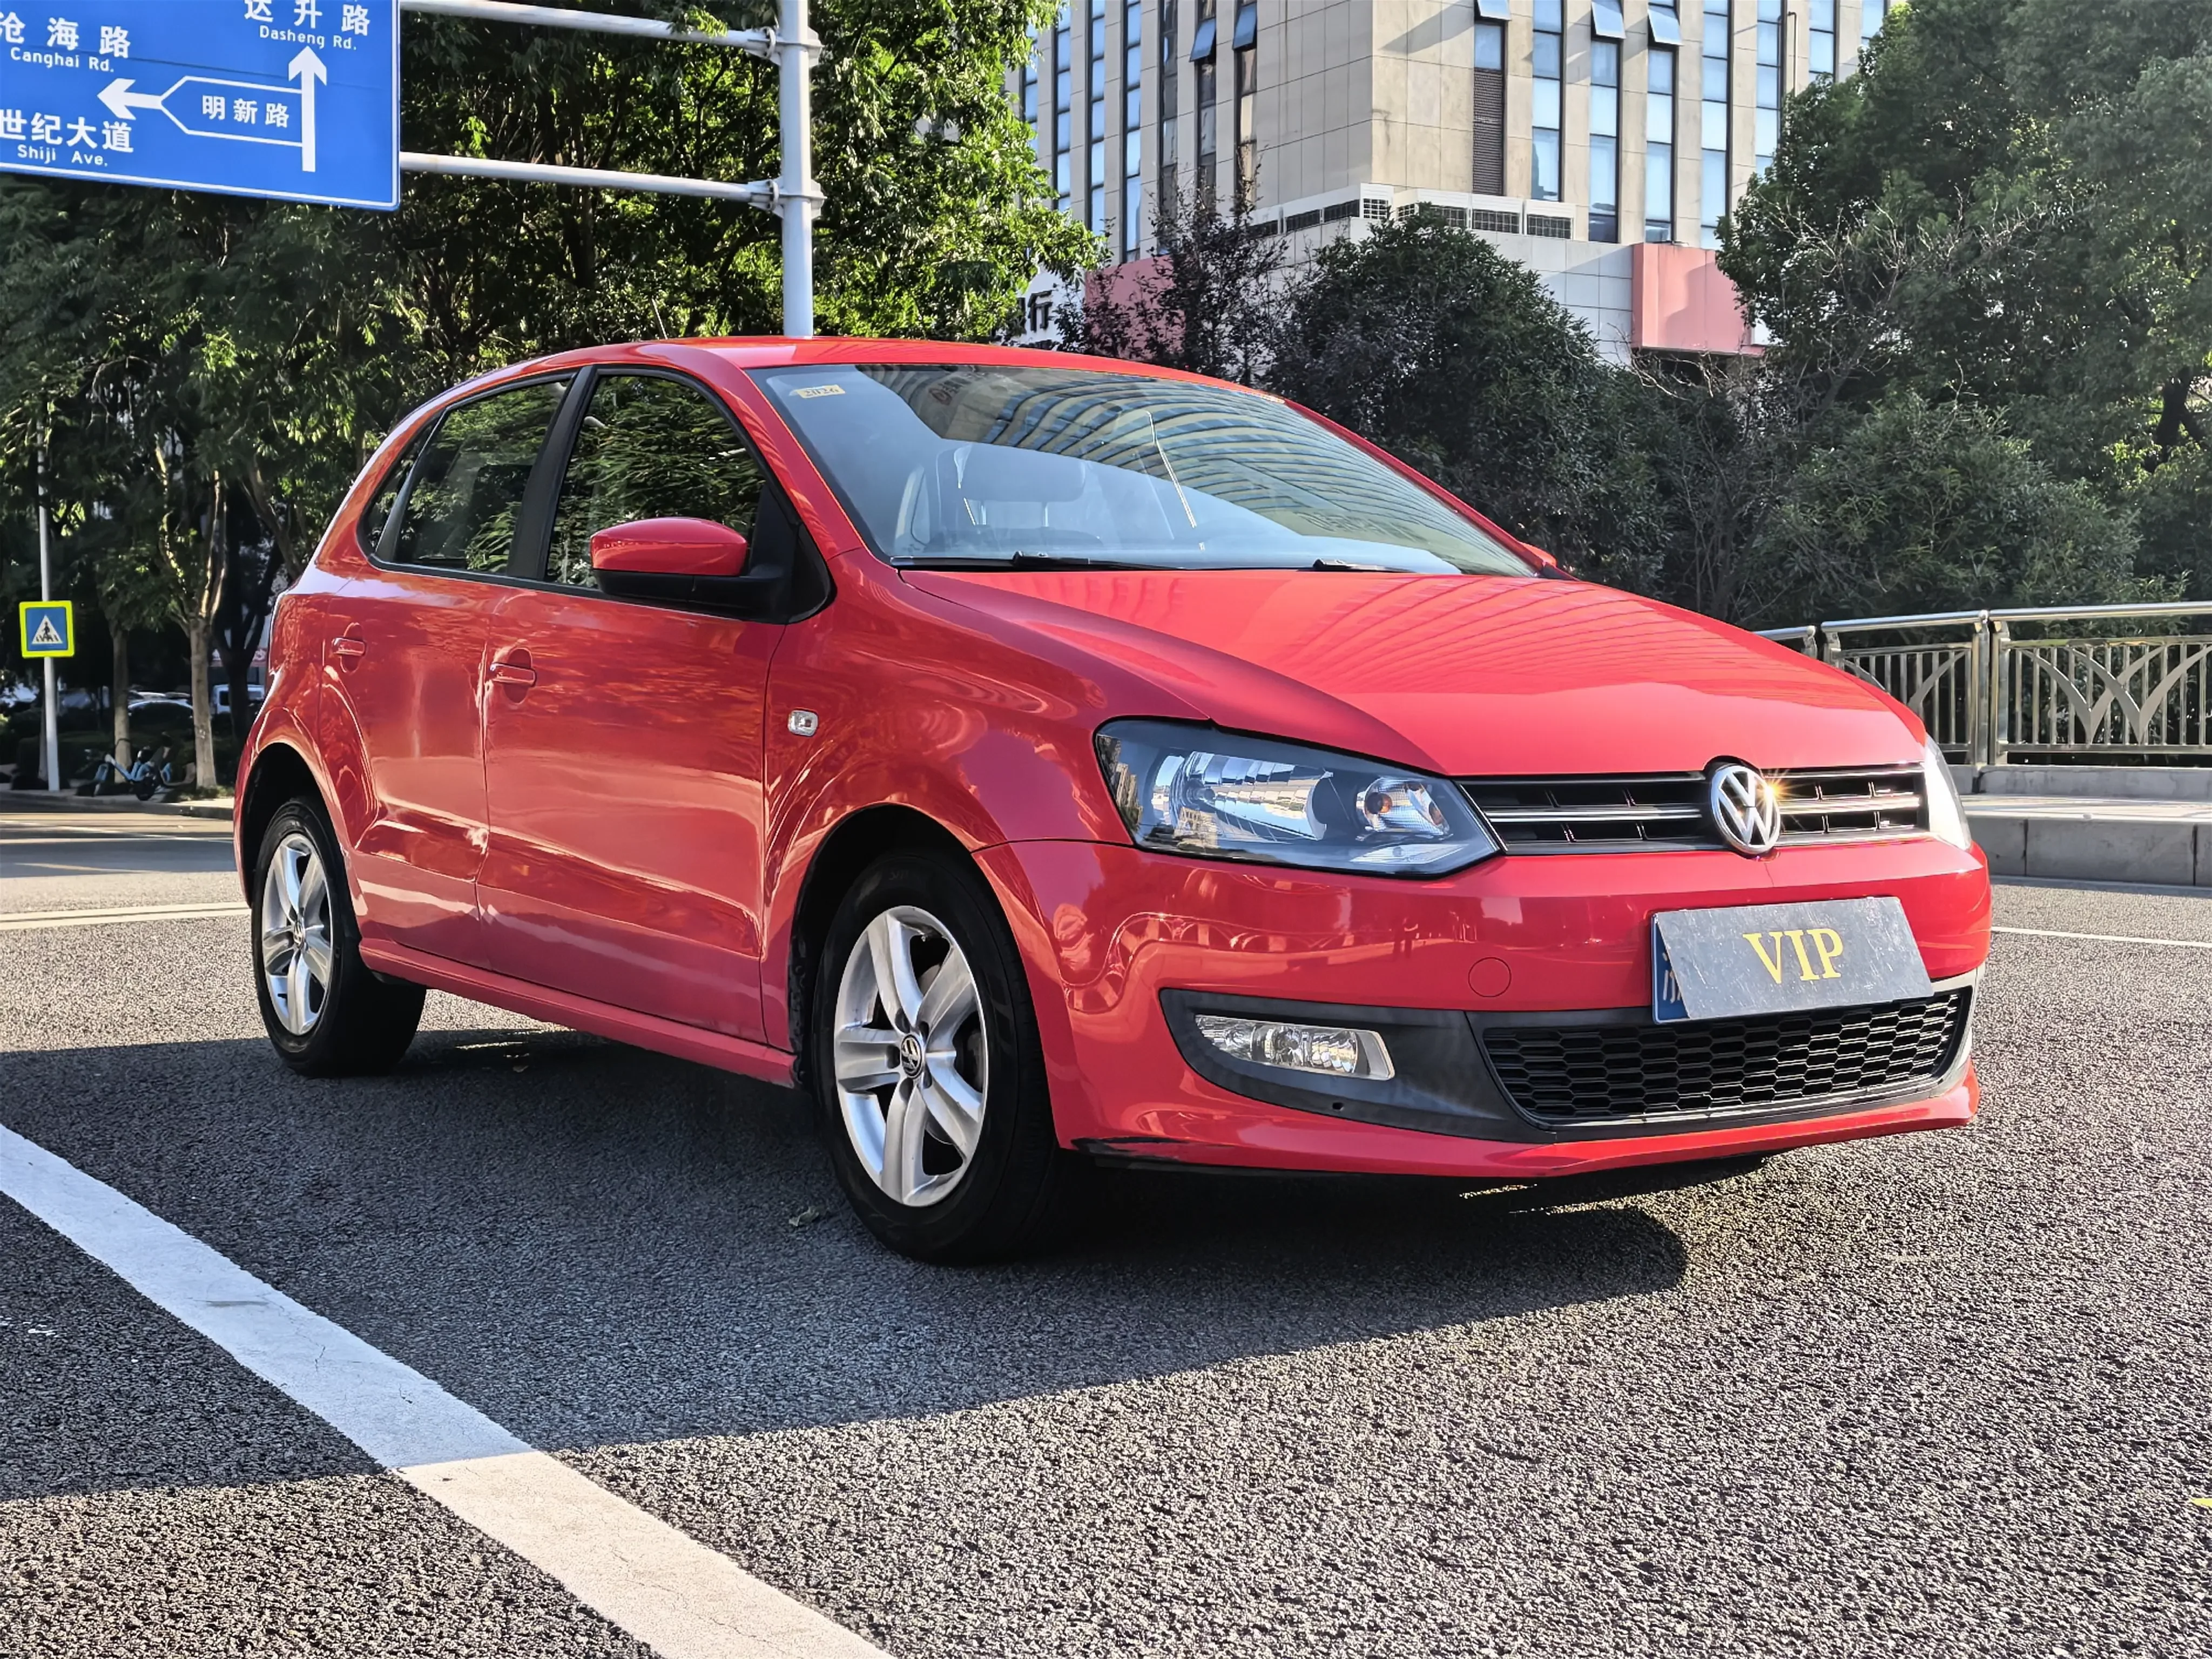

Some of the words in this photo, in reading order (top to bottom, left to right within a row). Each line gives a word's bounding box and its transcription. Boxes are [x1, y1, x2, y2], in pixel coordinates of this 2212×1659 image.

[0, 11, 131, 58] 沧海路
[244, 0, 370, 36] 达升路
[259, 25, 325, 50] Dasheng
[333, 35, 357, 50] Rd.
[10, 46, 80, 69] Canghai
[88, 56, 114, 73] Rd.
[202, 95, 289, 129] 明新路
[0, 108, 134, 153] 世纪大道
[17, 144, 57, 165] Shiji
[71, 150, 108, 167] Ave.
[1742, 927, 1844, 984] VIP
